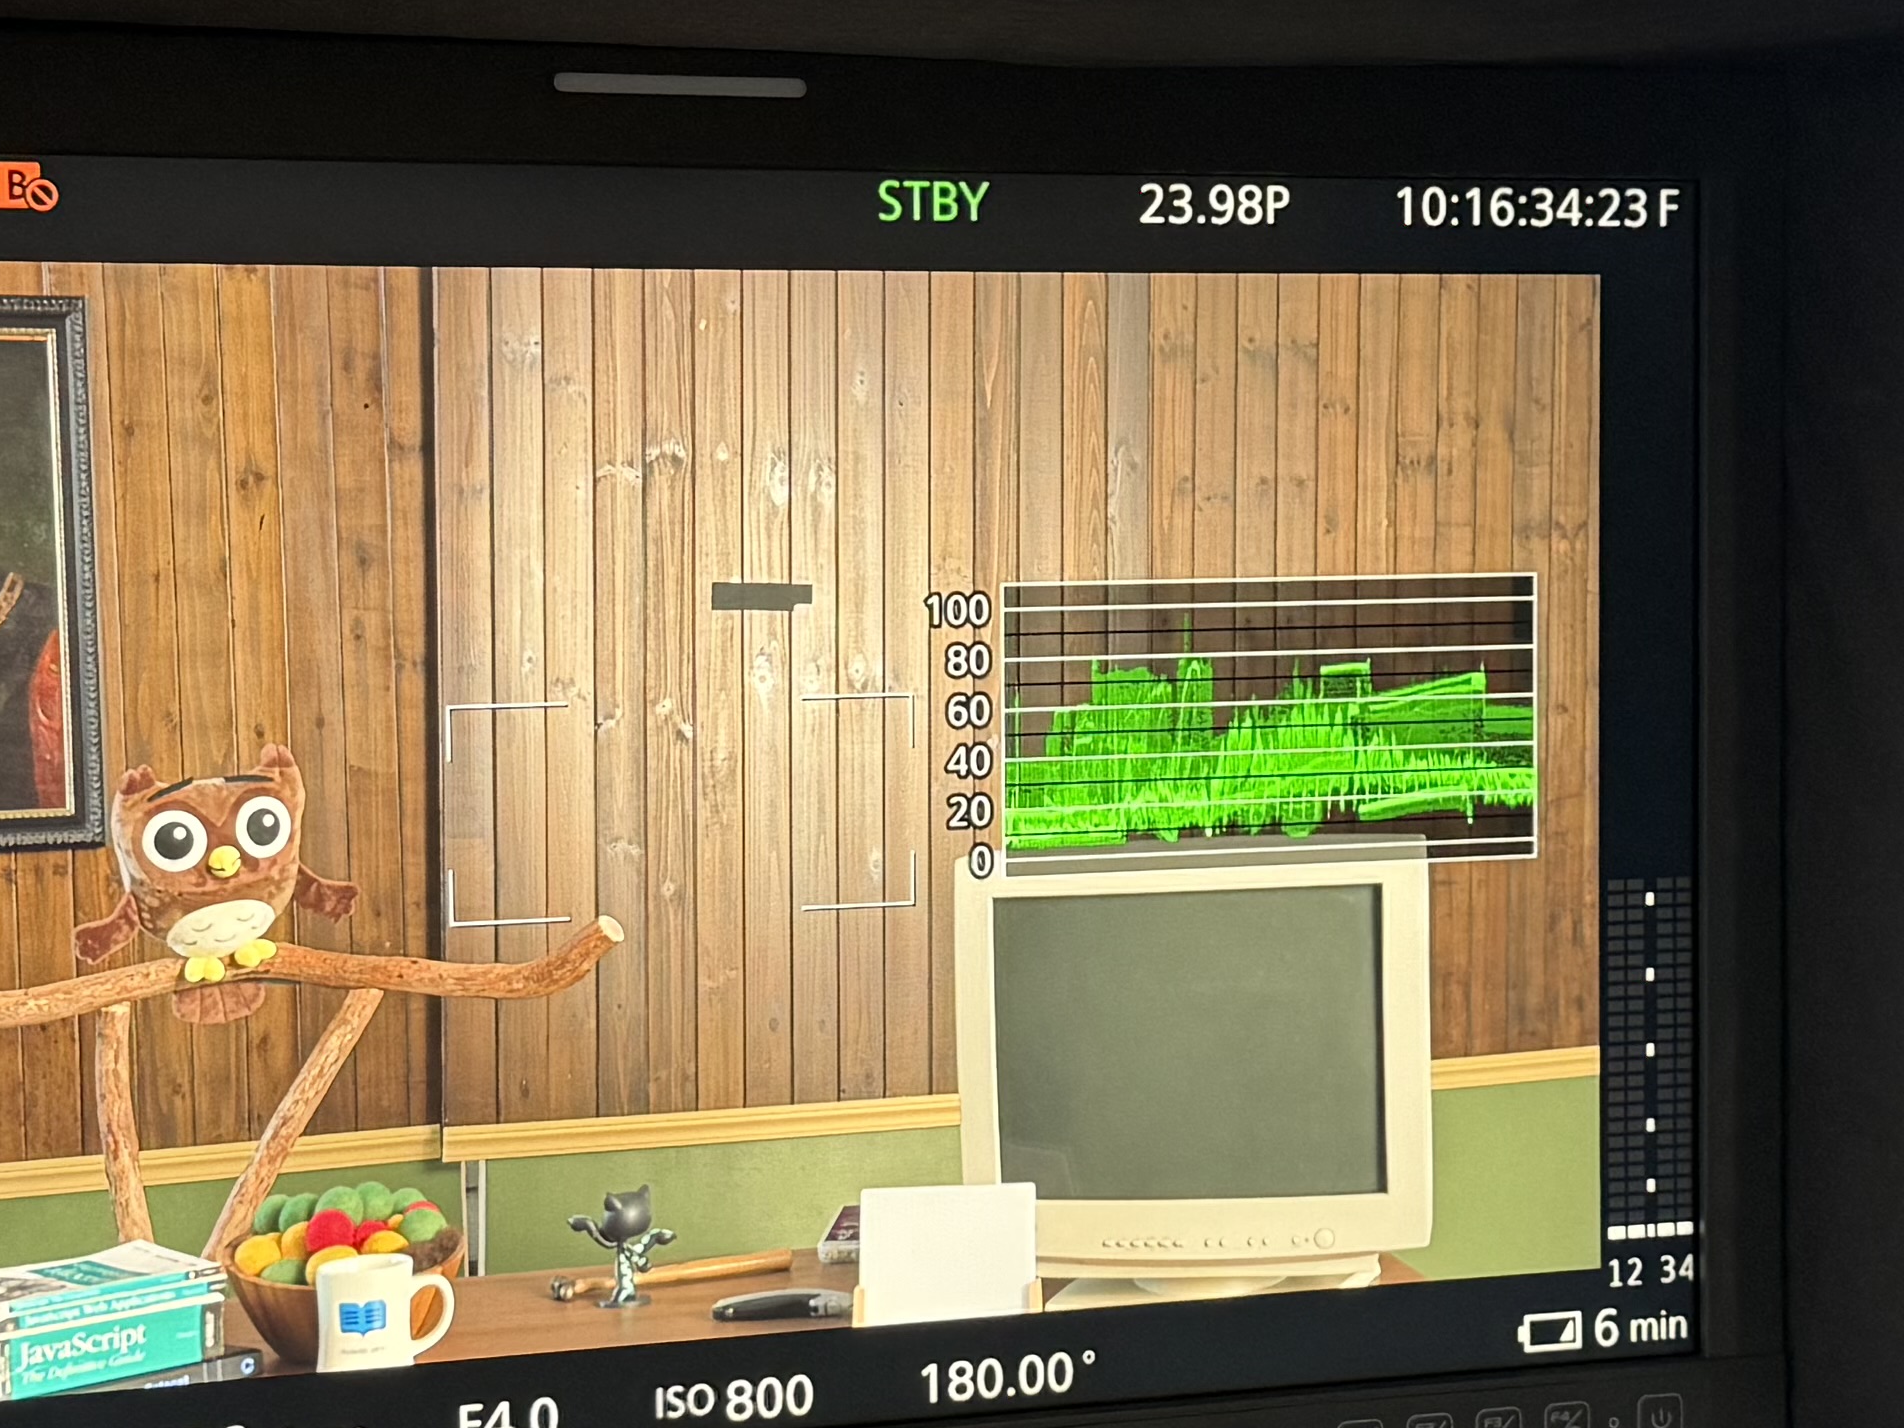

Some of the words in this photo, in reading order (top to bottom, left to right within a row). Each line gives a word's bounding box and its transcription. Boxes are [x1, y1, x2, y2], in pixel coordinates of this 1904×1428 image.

[877, 179, 990, 222] STBY
[1139, 182, 1291, 226] 23.98P
[925, 592, 991, 627] 100
[946, 642, 992, 678] 80
[946, 692, 992, 729] 60
[945, 743, 992, 779] 40
[947, 793, 993, 829] 20
[969, 842, 993, 878] 0
[1608, 1256, 1643, 1288] 12
[1594, 1307, 1620, 1348] 6
[1629, 1309, 1688, 1343] min
[17, 1323, 148, 1372] JavaScript
[655, 1382, 716, 1420] ISO
[725, 1373, 814, 1422] 800
